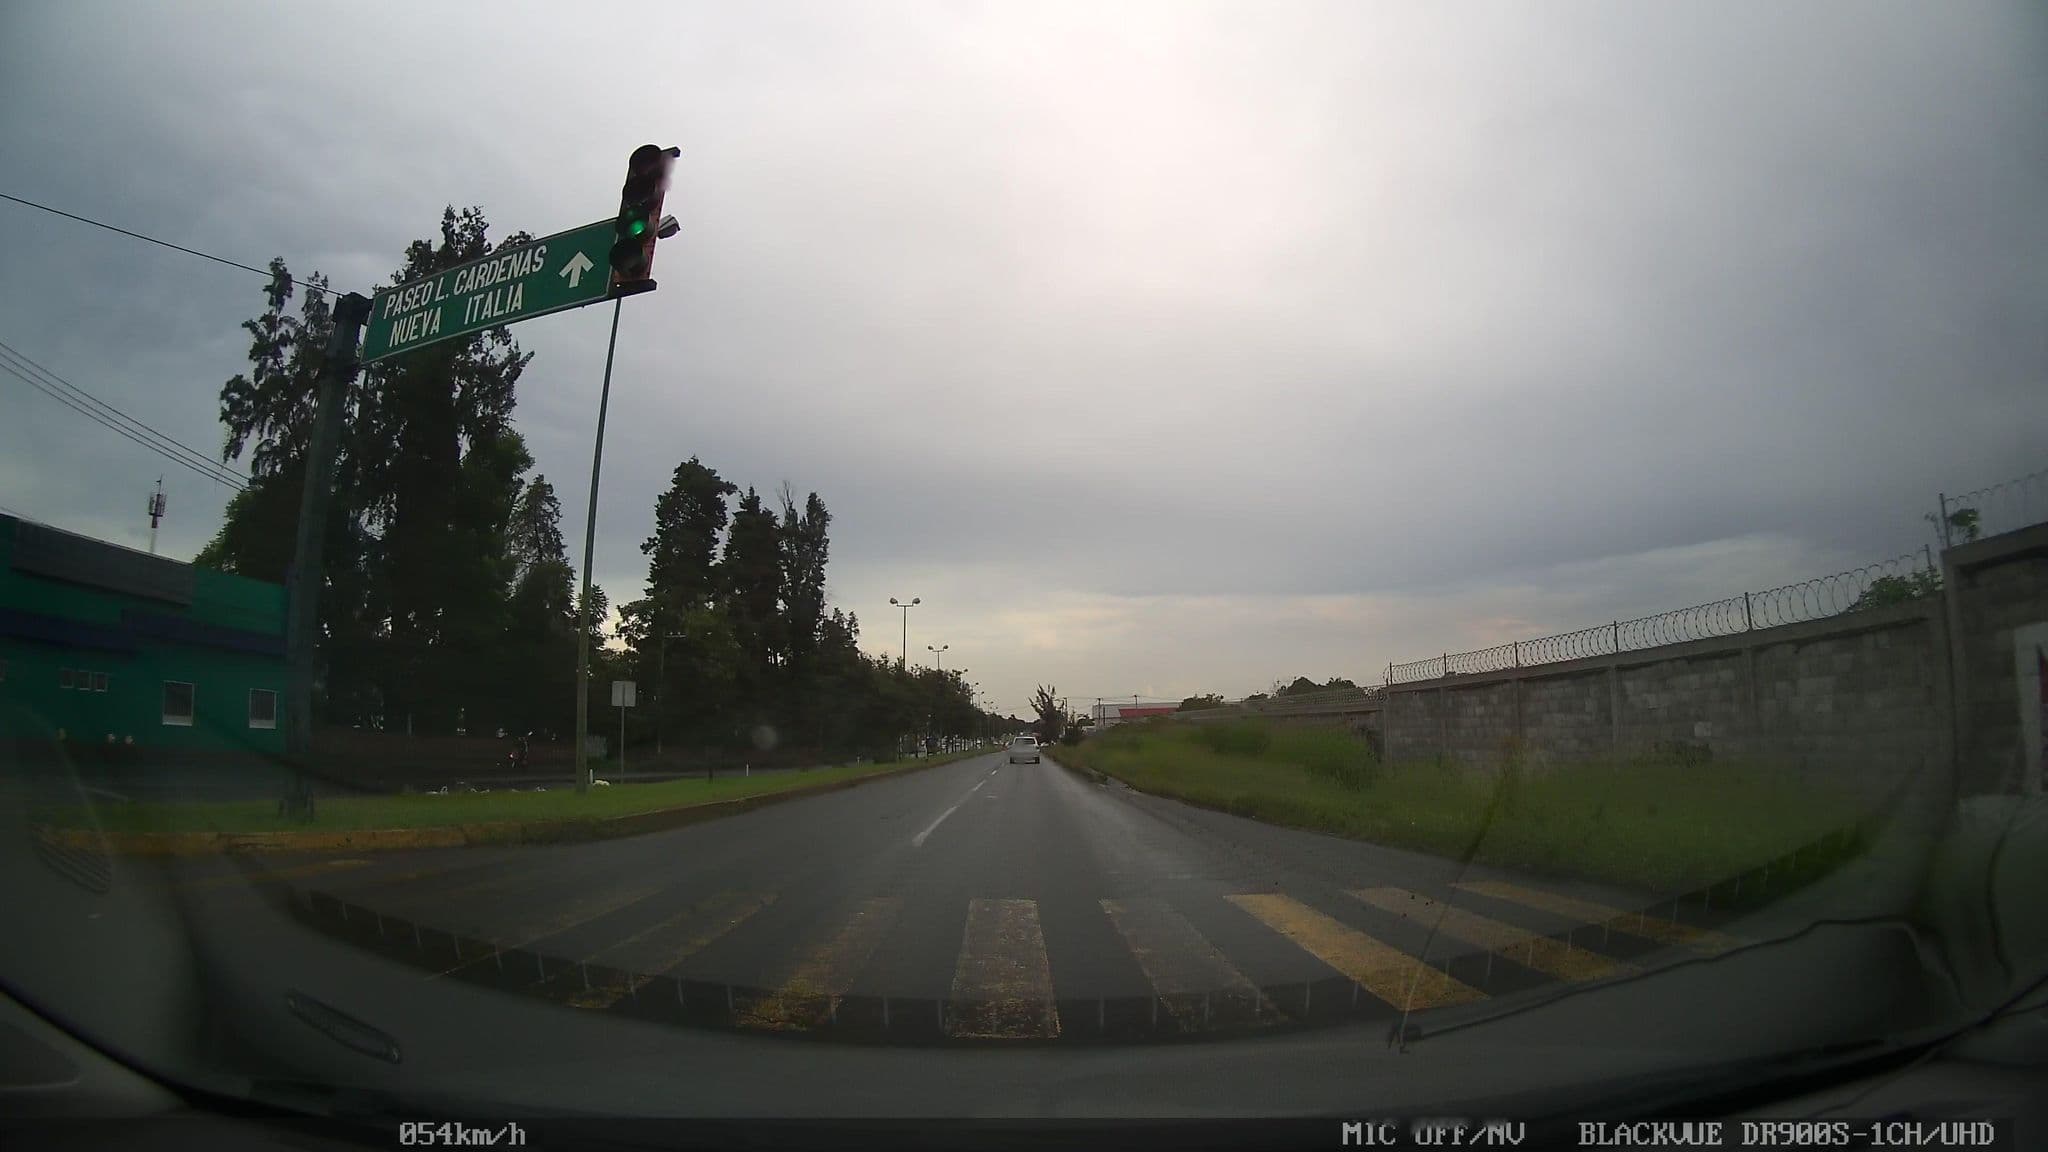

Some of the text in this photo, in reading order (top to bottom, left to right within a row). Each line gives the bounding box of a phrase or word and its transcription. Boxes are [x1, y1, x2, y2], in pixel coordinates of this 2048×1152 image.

[383, 246, 547, 320] PASEO L. CARDENAS
[389, 283, 523, 348] NUEVA ITALIA
